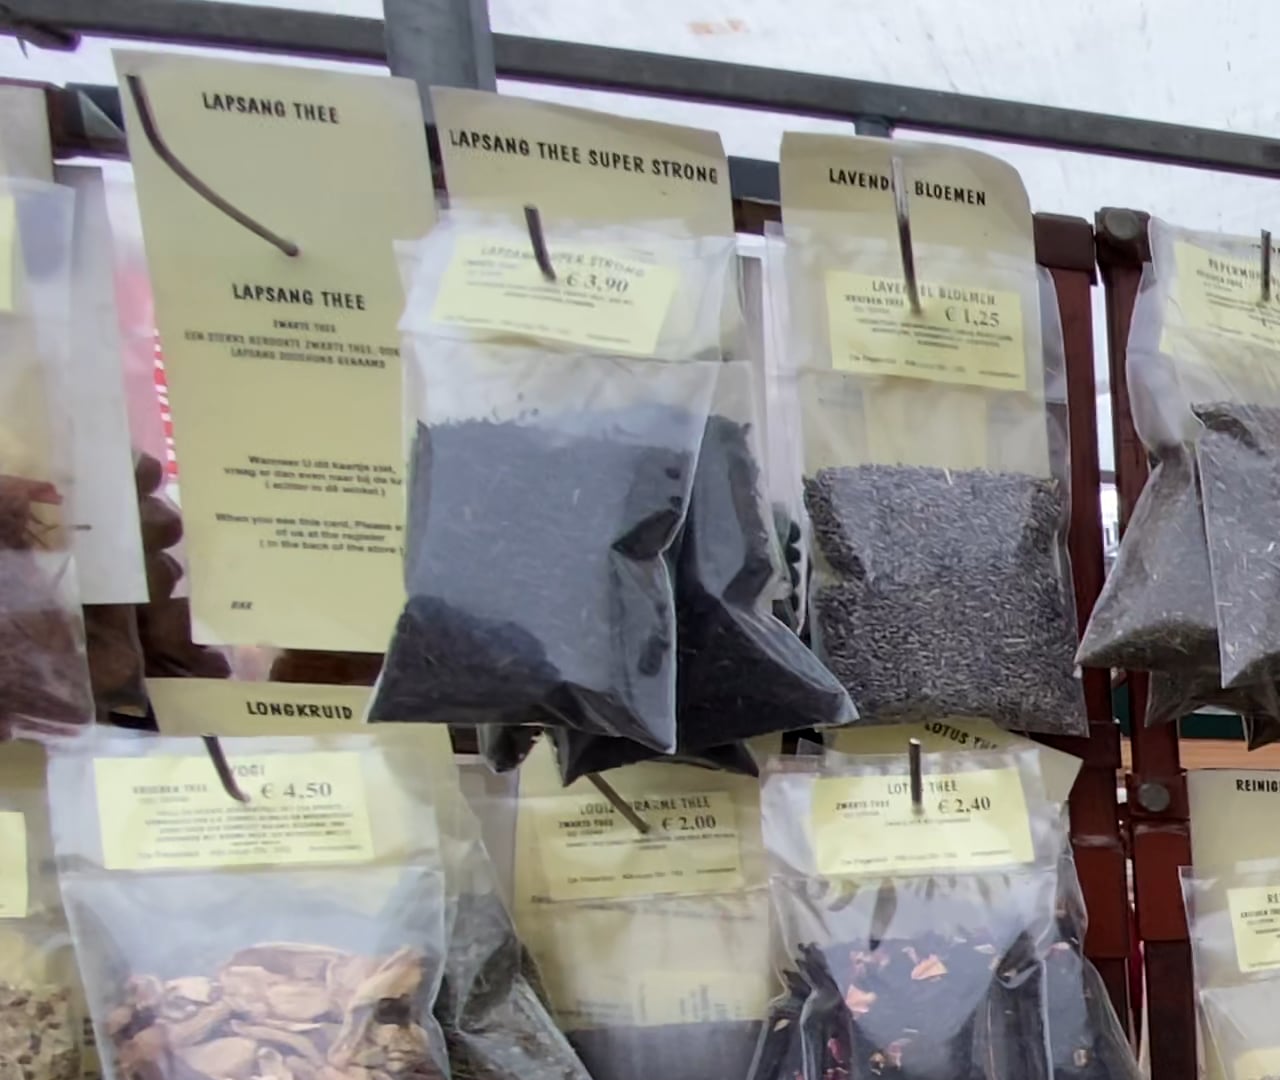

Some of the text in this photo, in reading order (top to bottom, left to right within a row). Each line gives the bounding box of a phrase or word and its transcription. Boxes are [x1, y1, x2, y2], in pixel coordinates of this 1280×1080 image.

[202, 92, 340, 124] LAPSANG THEE
[449, 128, 719, 184] LAPSANG THEE SUPER STRONG
[829, 168, 986, 205] LAVEND BLOEMEN
[590, 256, 646, 277] STRONG
[566, 275, 578, 287] €
[232, 283, 366, 311] LAPSANG THEE
[872, 280, 996, 306] LAVEEL BLOEMEN
[945, 307, 1000, 327] € 1,25
[215, 513, 249, 522] When
[252, 517, 273, 525] you
[246, 702, 352, 720] LONGKRUID
[261, 784, 274, 798] €
[888, 781, 957, 794] LOT THEE
[938, 800, 949, 814] €
[662, 818, 672, 830] €
